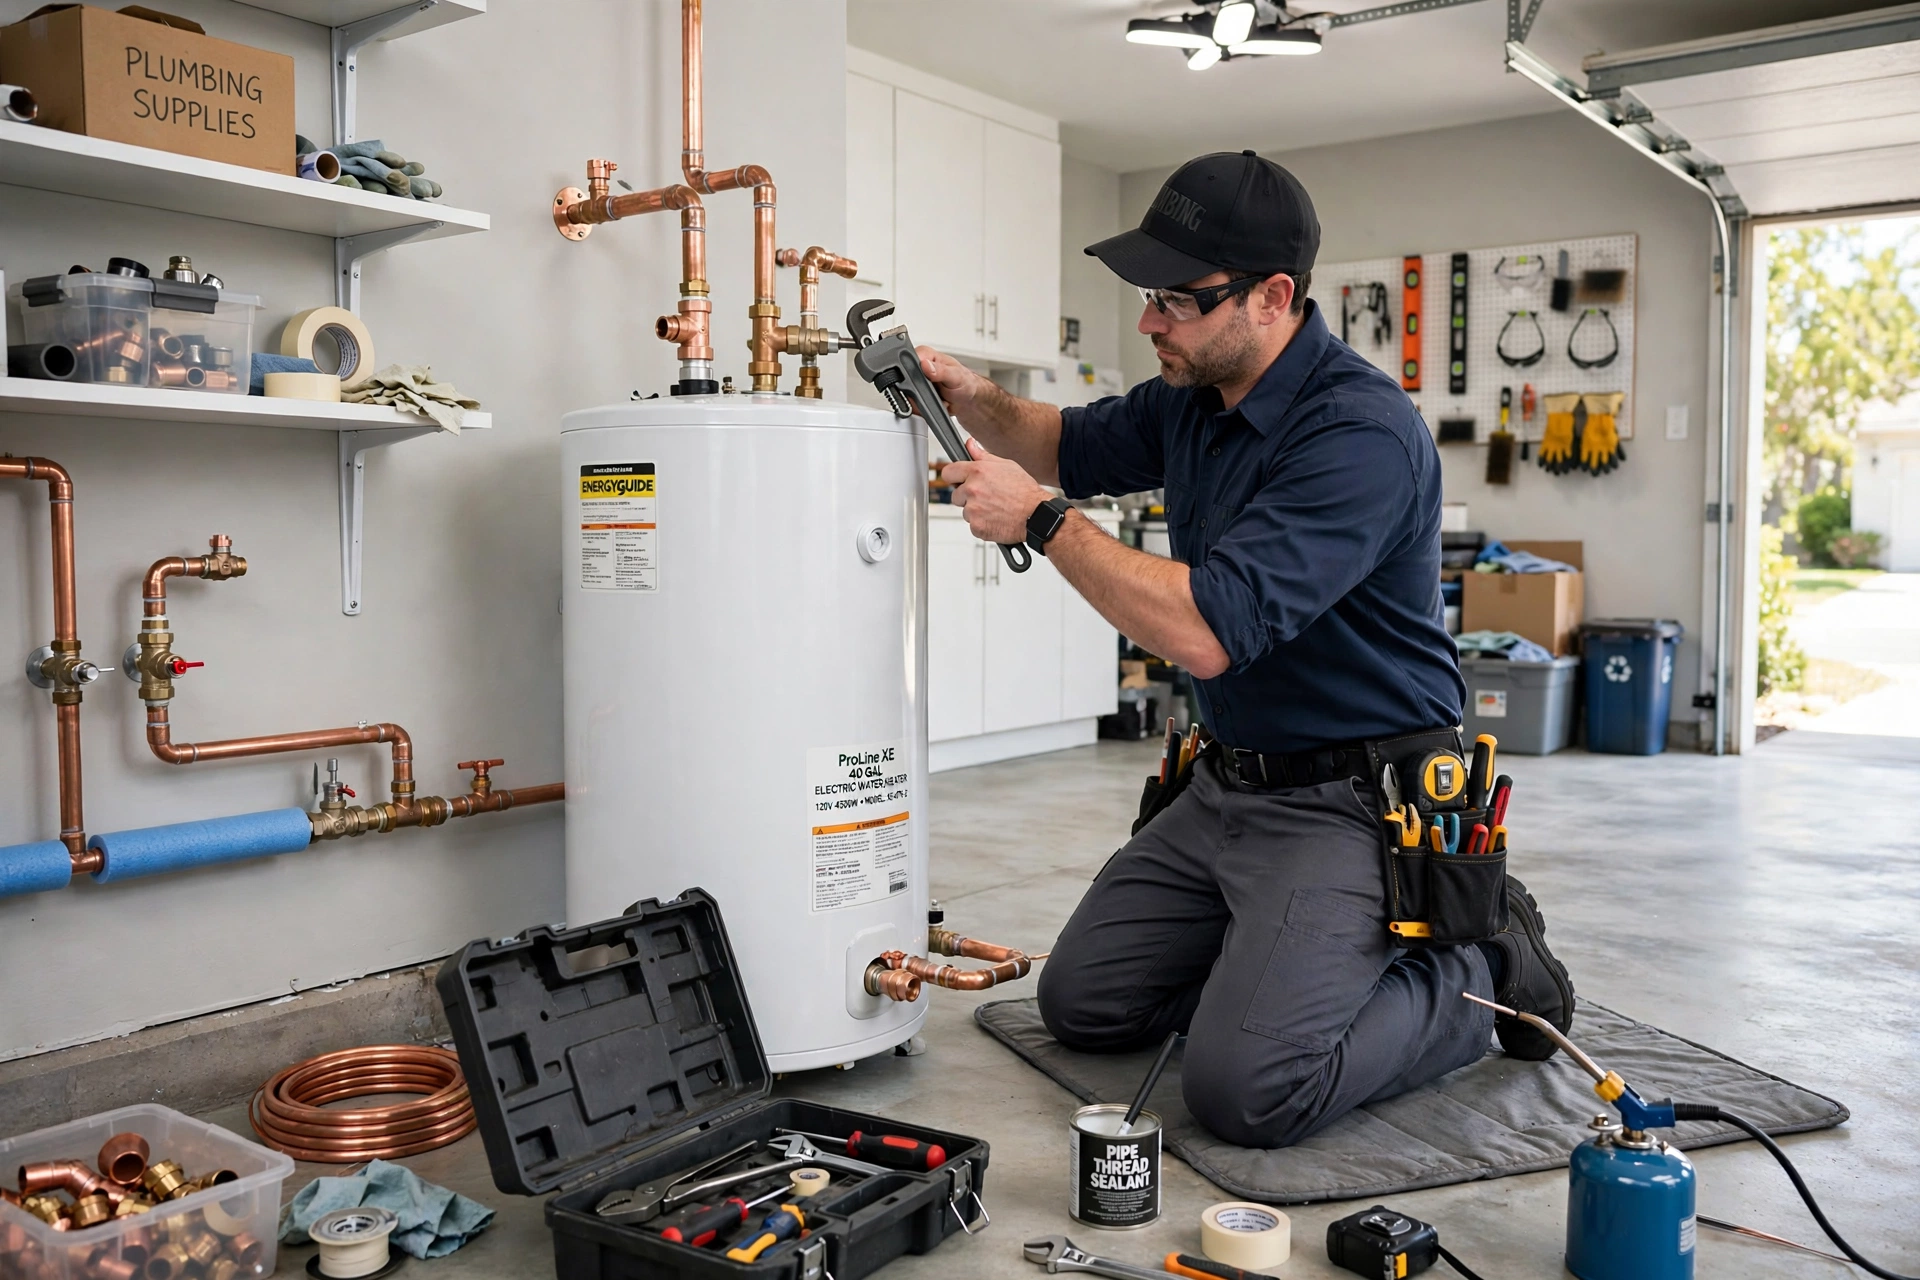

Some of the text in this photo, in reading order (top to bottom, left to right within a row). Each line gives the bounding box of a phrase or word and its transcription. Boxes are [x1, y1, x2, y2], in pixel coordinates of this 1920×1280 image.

[125, 46, 262, 104] PLUMBING
[133, 88, 256, 139] SUPPLIES
[1150, 185, 1207, 232] MBING
[582, 479, 654, 496] ENERGYGUIDE
[838, 747, 895, 767] ProLine XE
[848, 765, 883, 779] 40 GAL
[814, 781, 857, 795] ELECTRIC
[815, 801, 833, 811] 120V
[1106, 1144, 1139, 1160] PIPE
[1093, 1157, 1150, 1176] THREAD
[1090, 1170, 1151, 1191] SEALANT
